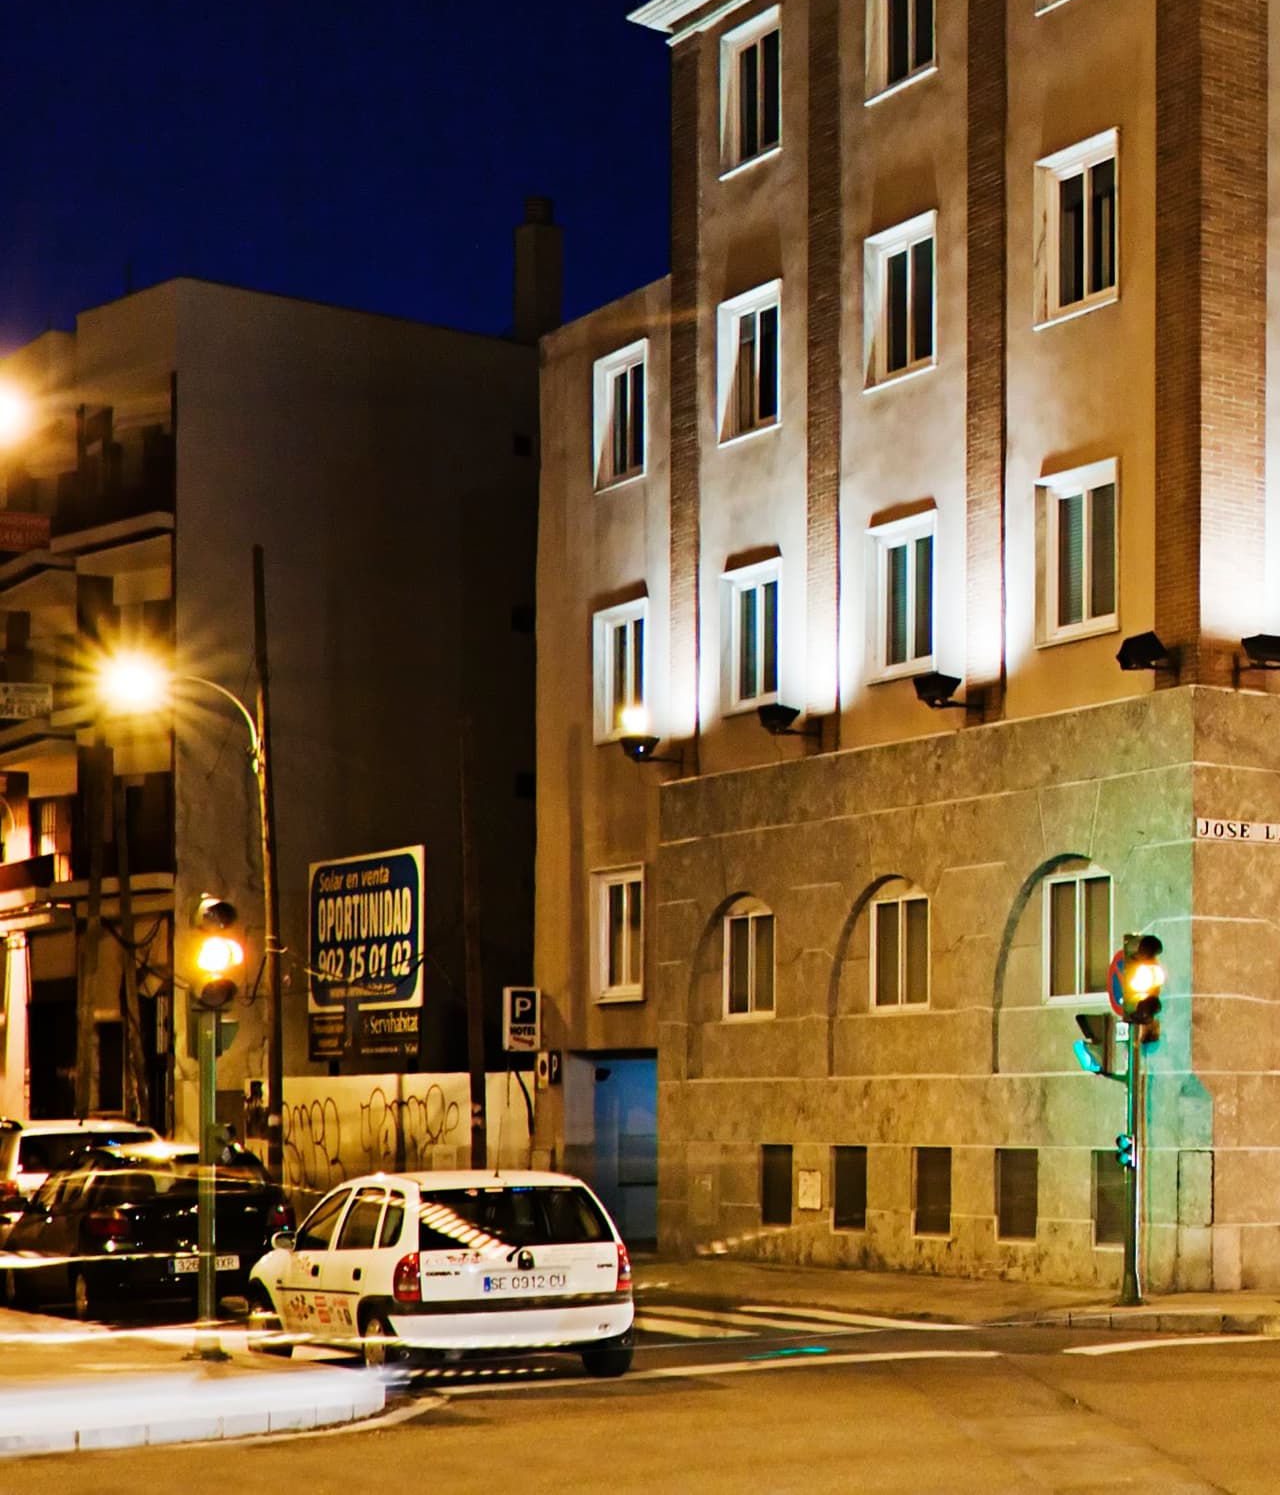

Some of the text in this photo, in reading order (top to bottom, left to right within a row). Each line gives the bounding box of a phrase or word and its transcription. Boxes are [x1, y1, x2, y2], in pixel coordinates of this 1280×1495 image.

[1200, 820, 1250, 838] JOSE
[320, 865, 390, 893] Solar en venta
[318, 886, 412, 943] OPORTUNIDAD
[318, 940, 411, 983] 902 15 01 02
[515, 998, 532, 1019] P
[370, 1011, 418, 1034] Servihabitat
[490, 1277, 507, 1290] SE
[549, 1273, 566, 1288] CU
